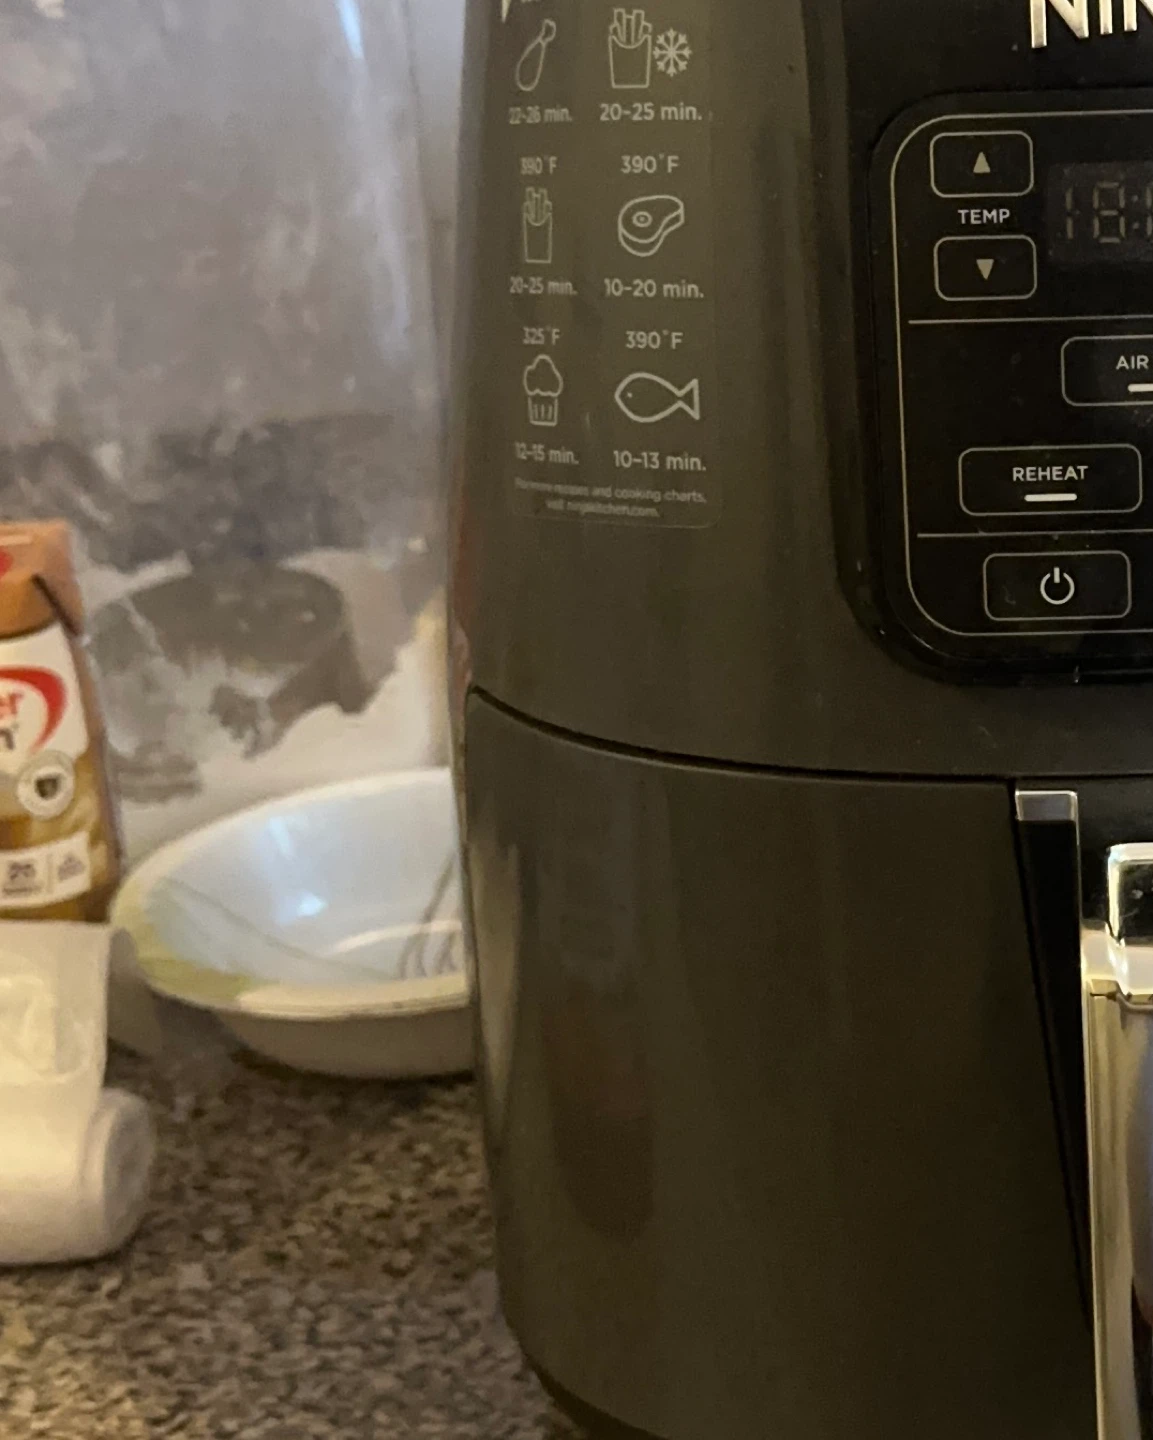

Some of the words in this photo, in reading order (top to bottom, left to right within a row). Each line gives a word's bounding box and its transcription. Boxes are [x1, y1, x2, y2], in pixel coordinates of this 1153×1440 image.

[600, 102, 654, 121] 20-25
[660, 102, 702, 121] min.
[620, 153, 679, 174] 390°F
[957, 209, 1011, 225] TEMP
[547, 277, 578, 296] min.
[603, 278, 656, 297] 10-20
[662, 280, 704, 298] min.
[625, 329, 683, 349] 390°F
[1116, 355, 1149, 370] AIR
[549, 446, 579, 465] min.
[613, 449, 660, 469] 10-13
[665, 452, 706, 471] min.
[1012, 465, 1088, 482] REHEAT
